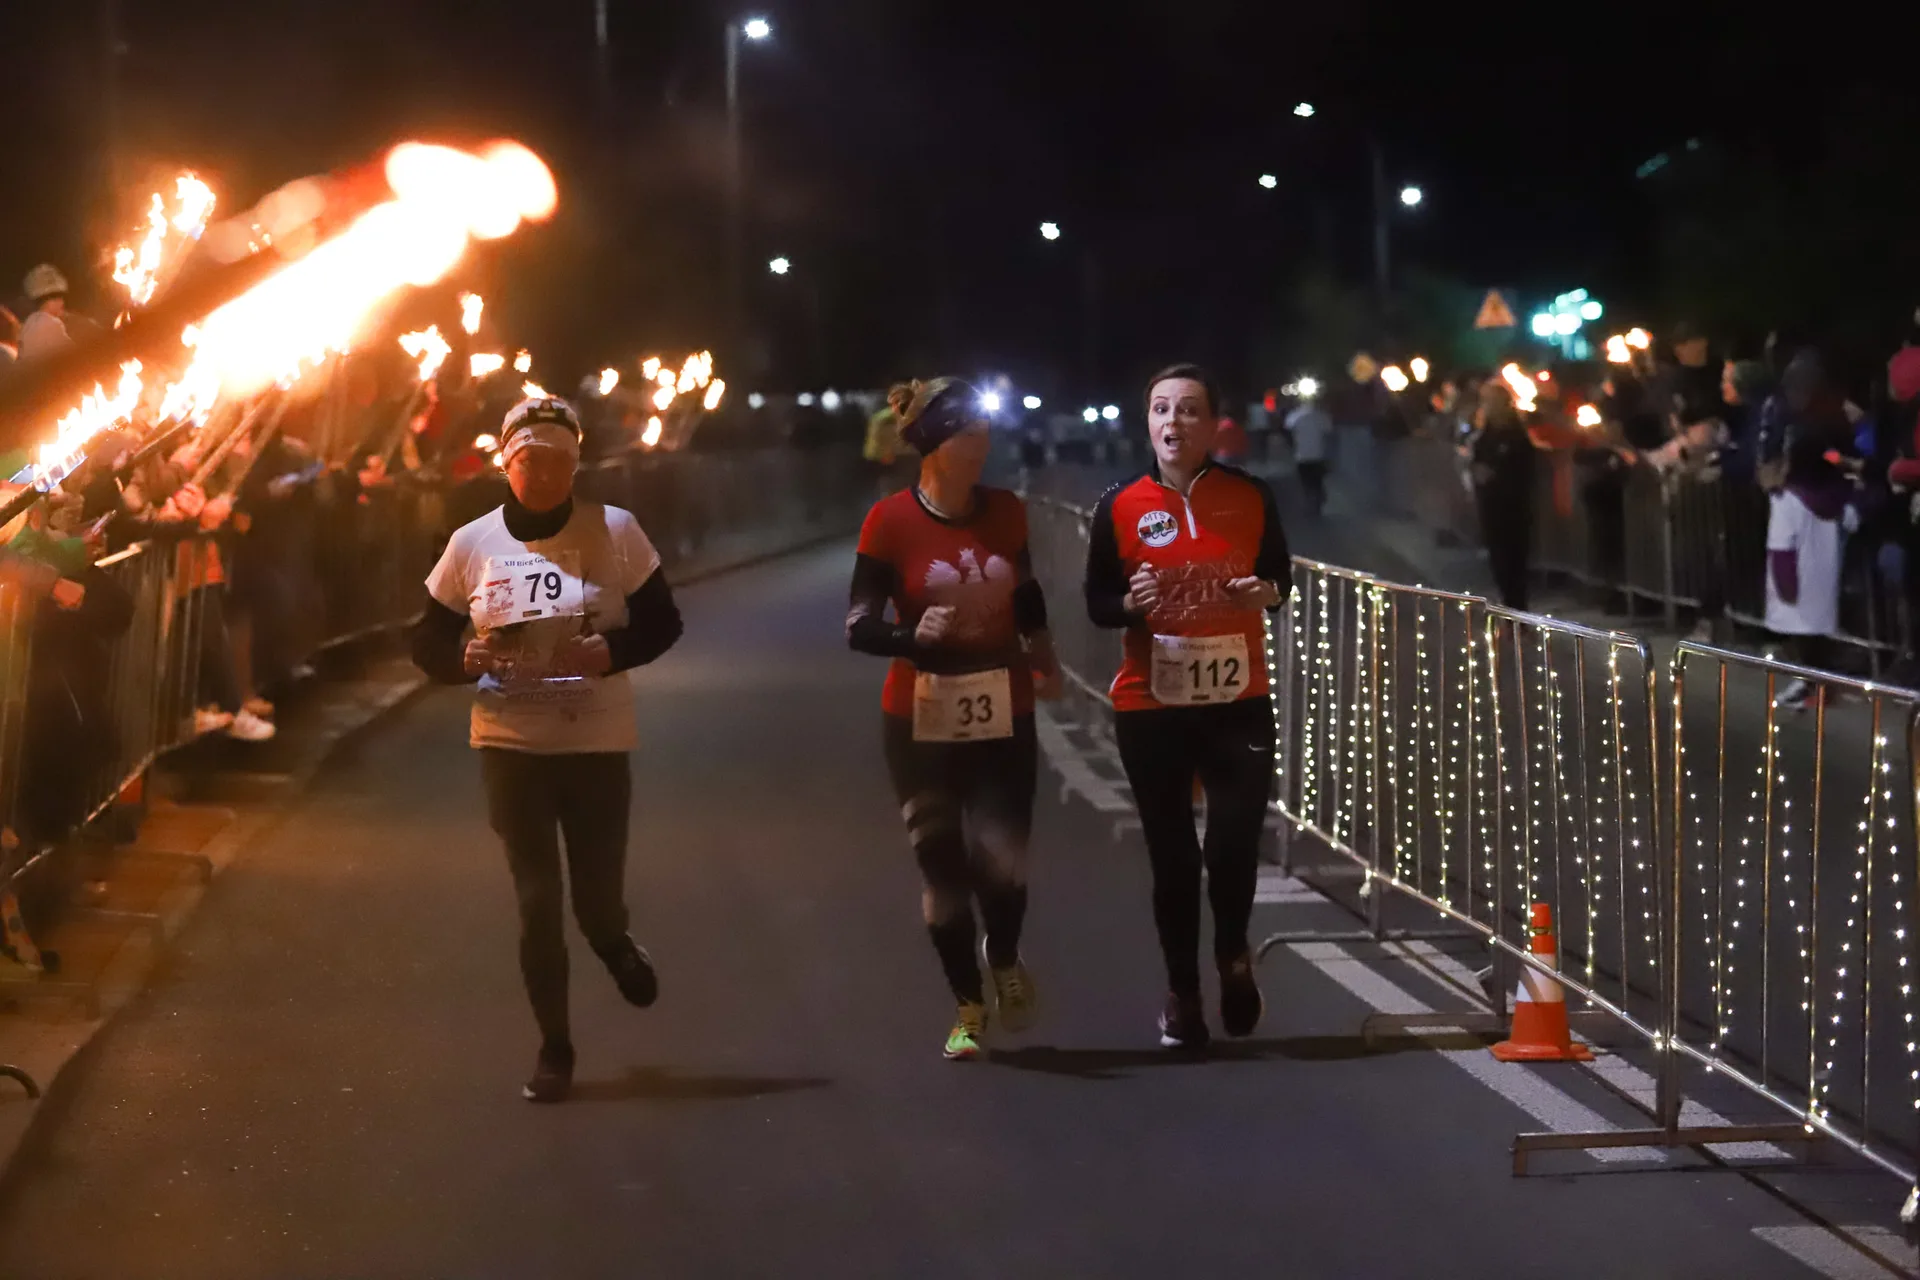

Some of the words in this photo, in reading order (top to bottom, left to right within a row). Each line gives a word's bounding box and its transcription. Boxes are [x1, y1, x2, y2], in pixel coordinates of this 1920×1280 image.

[1143, 511, 1166, 523] MTS
[525, 571, 562, 603] 79
[1188, 657, 1240, 689] 112
[957, 693, 993, 727] 33
